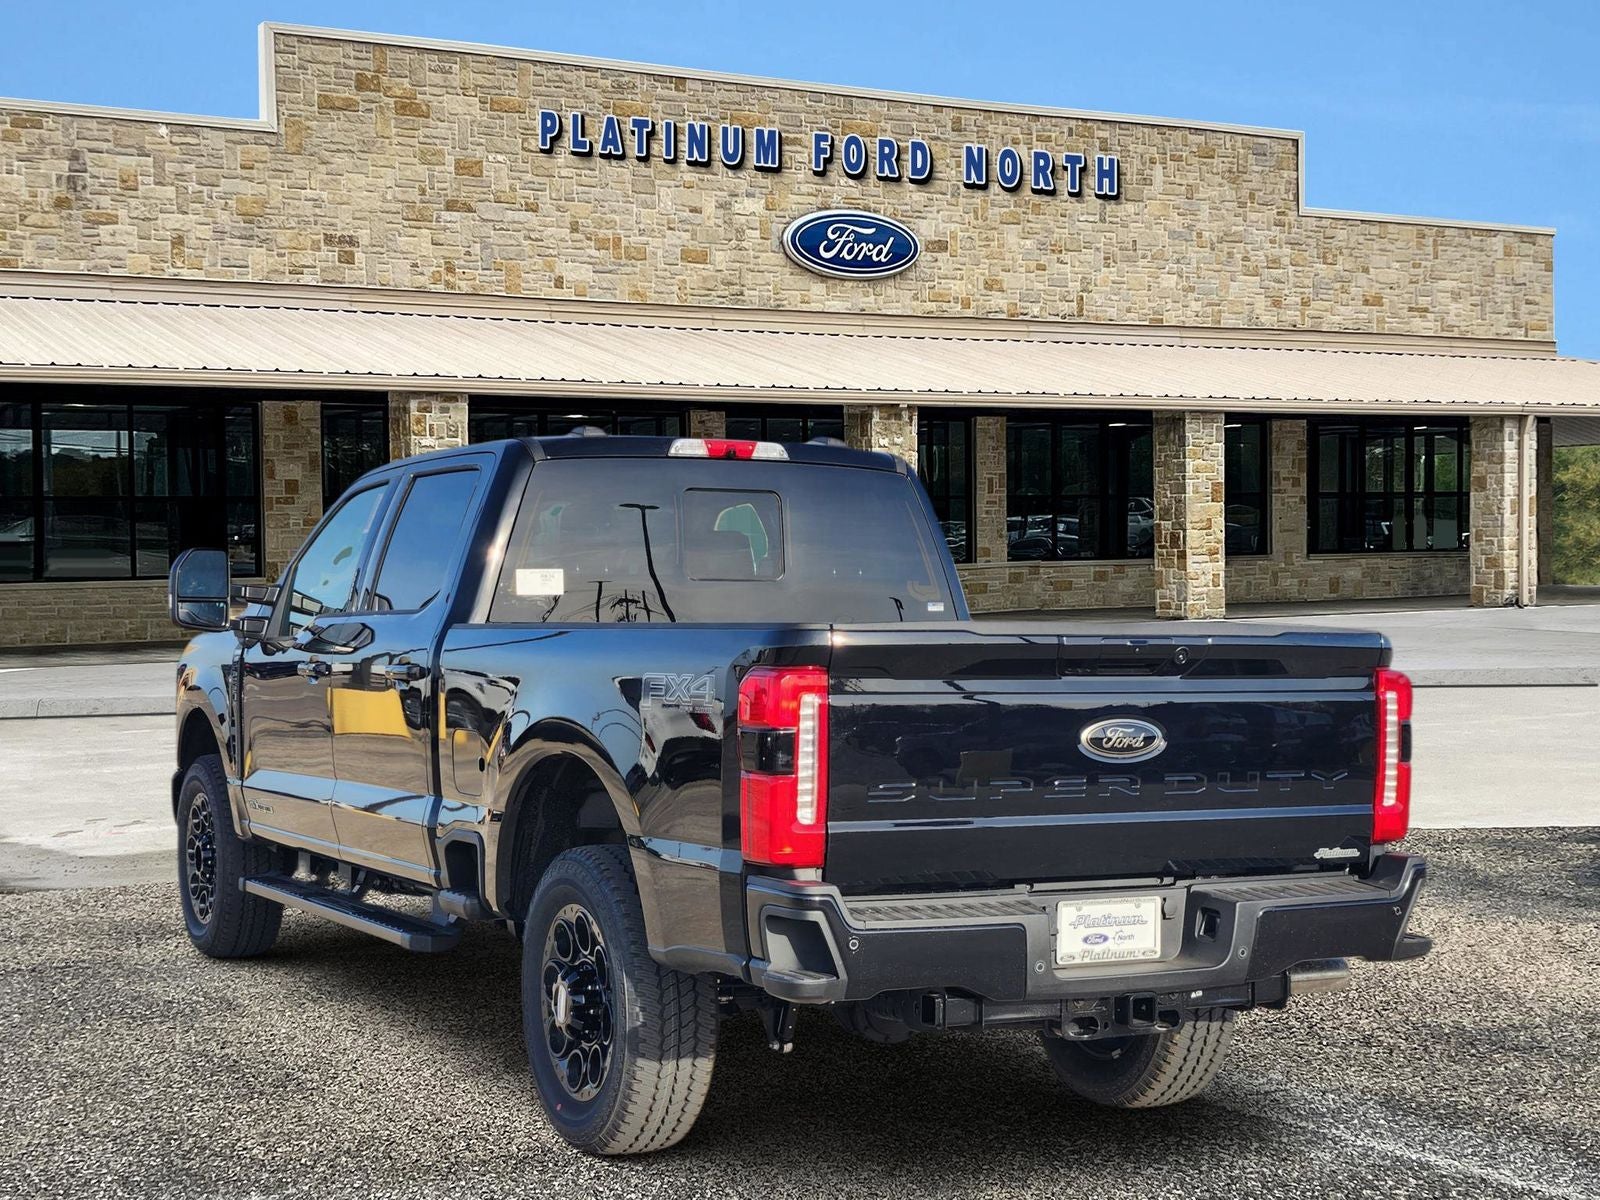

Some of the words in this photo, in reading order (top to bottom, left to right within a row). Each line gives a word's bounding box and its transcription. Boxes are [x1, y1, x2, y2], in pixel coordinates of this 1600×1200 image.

[538, 109, 783, 174] PLATINUM
[812, 131, 933, 184] FORD
[963, 145, 1121, 200] NORTH
[818, 223, 896, 265] Ford
[641, 672, 716, 707] FX4
[1102, 726, 1145, 749] Ford
[866, 774, 1141, 803] SUPER
[1164, 769, 1349, 795] DUTY
[1069, 913, 1148, 929] Platinum
[1117, 934, 1136, 942] North
[1081, 948, 1137, 961] Platinum
